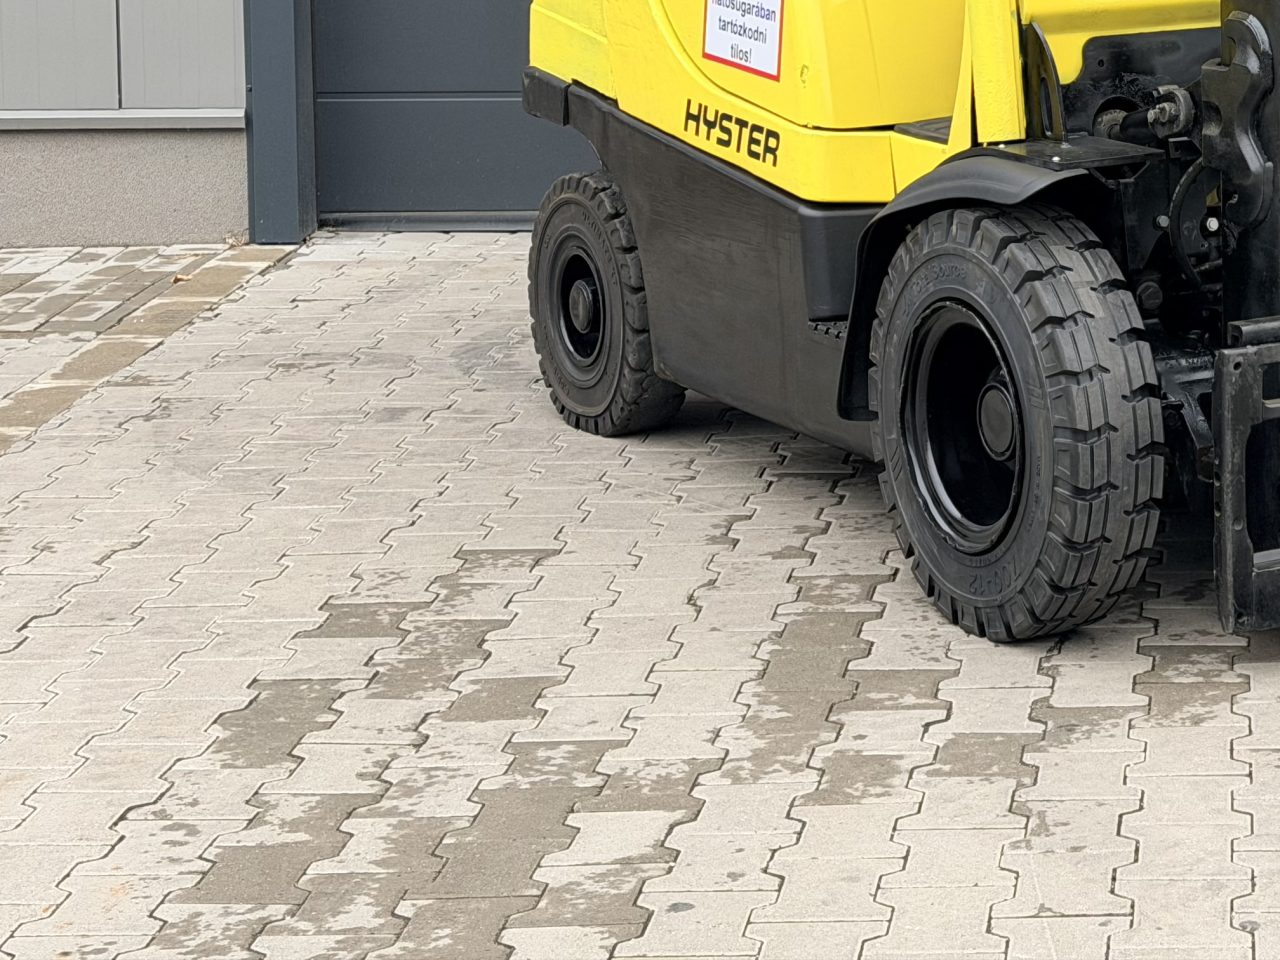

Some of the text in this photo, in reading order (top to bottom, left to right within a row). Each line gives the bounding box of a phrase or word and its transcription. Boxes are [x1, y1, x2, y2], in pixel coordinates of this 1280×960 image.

[718, 16, 767, 44] tartózkodni
[731, 43, 752, 64] tilos!
[683, 98, 780, 167] HYSTER
